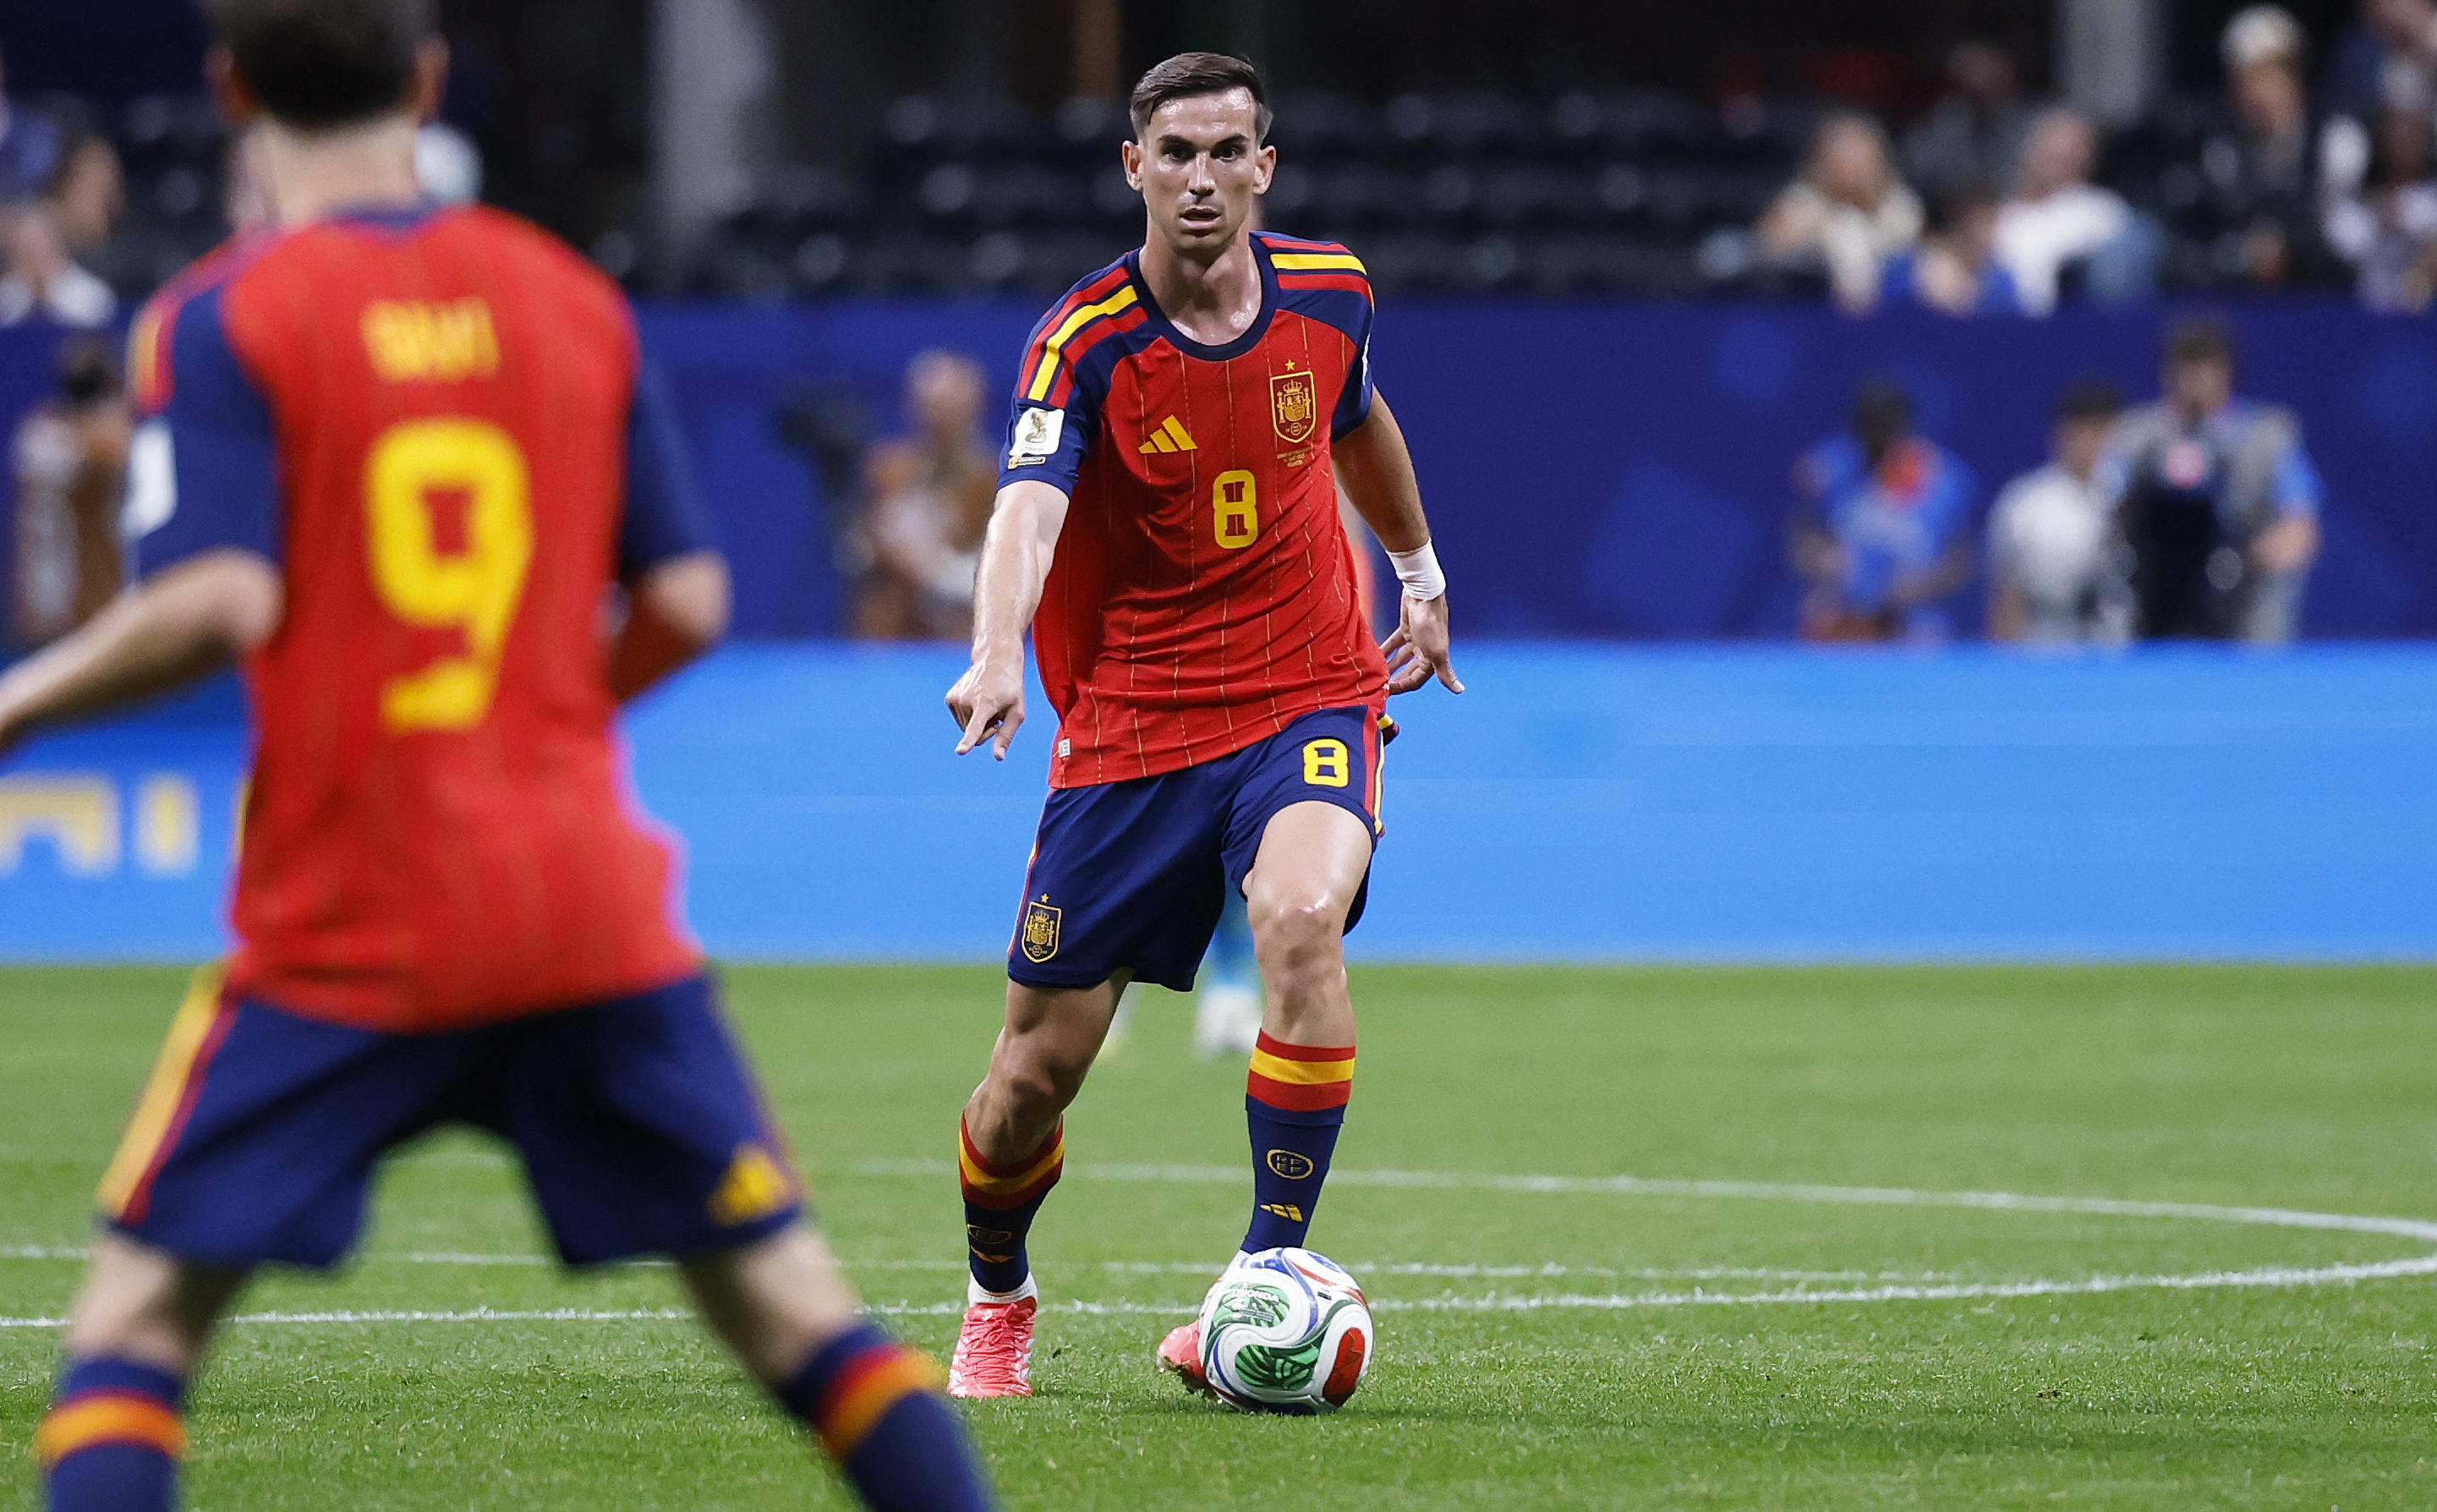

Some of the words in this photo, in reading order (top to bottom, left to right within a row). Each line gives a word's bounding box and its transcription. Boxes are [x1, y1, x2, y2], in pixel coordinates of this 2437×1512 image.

[1213, 469, 1258, 549] 8
[365, 419, 533, 732] 9
[1302, 738, 1350, 788] 8
